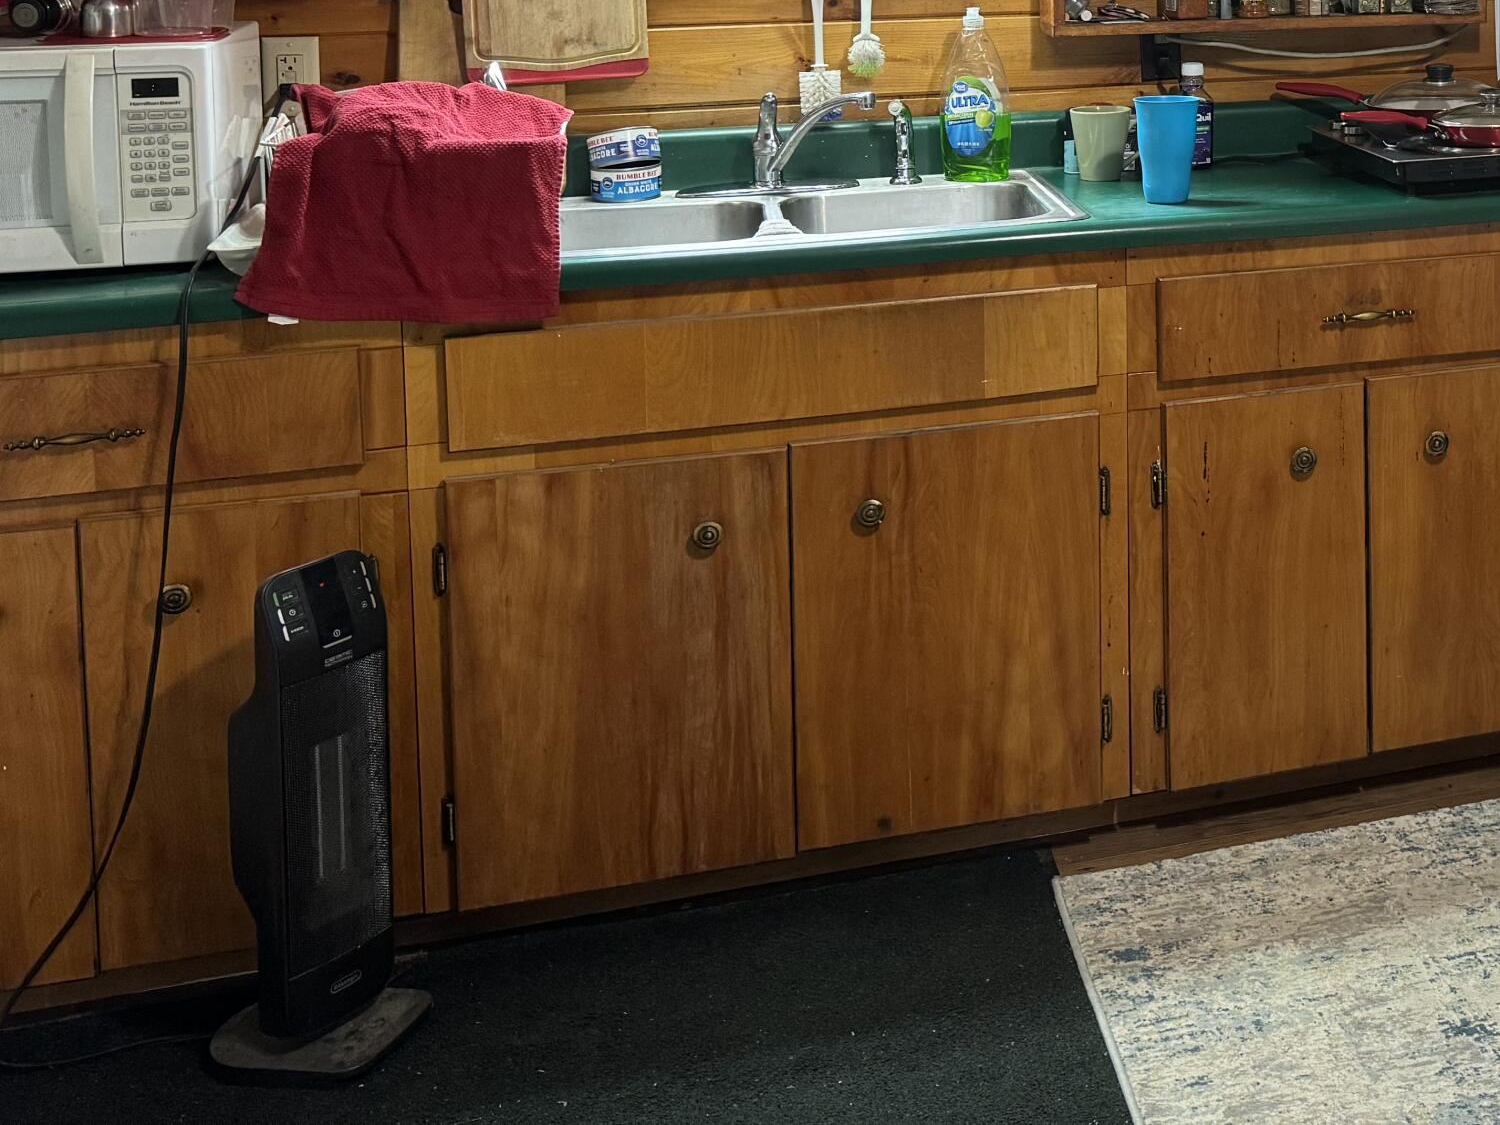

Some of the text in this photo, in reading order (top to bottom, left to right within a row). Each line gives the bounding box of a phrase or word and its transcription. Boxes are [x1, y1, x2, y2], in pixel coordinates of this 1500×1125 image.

[951, 94, 989, 109] ULTRA
[616, 171, 645, 180] BUMBLE
[617, 182, 659, 194] ALBACORE
